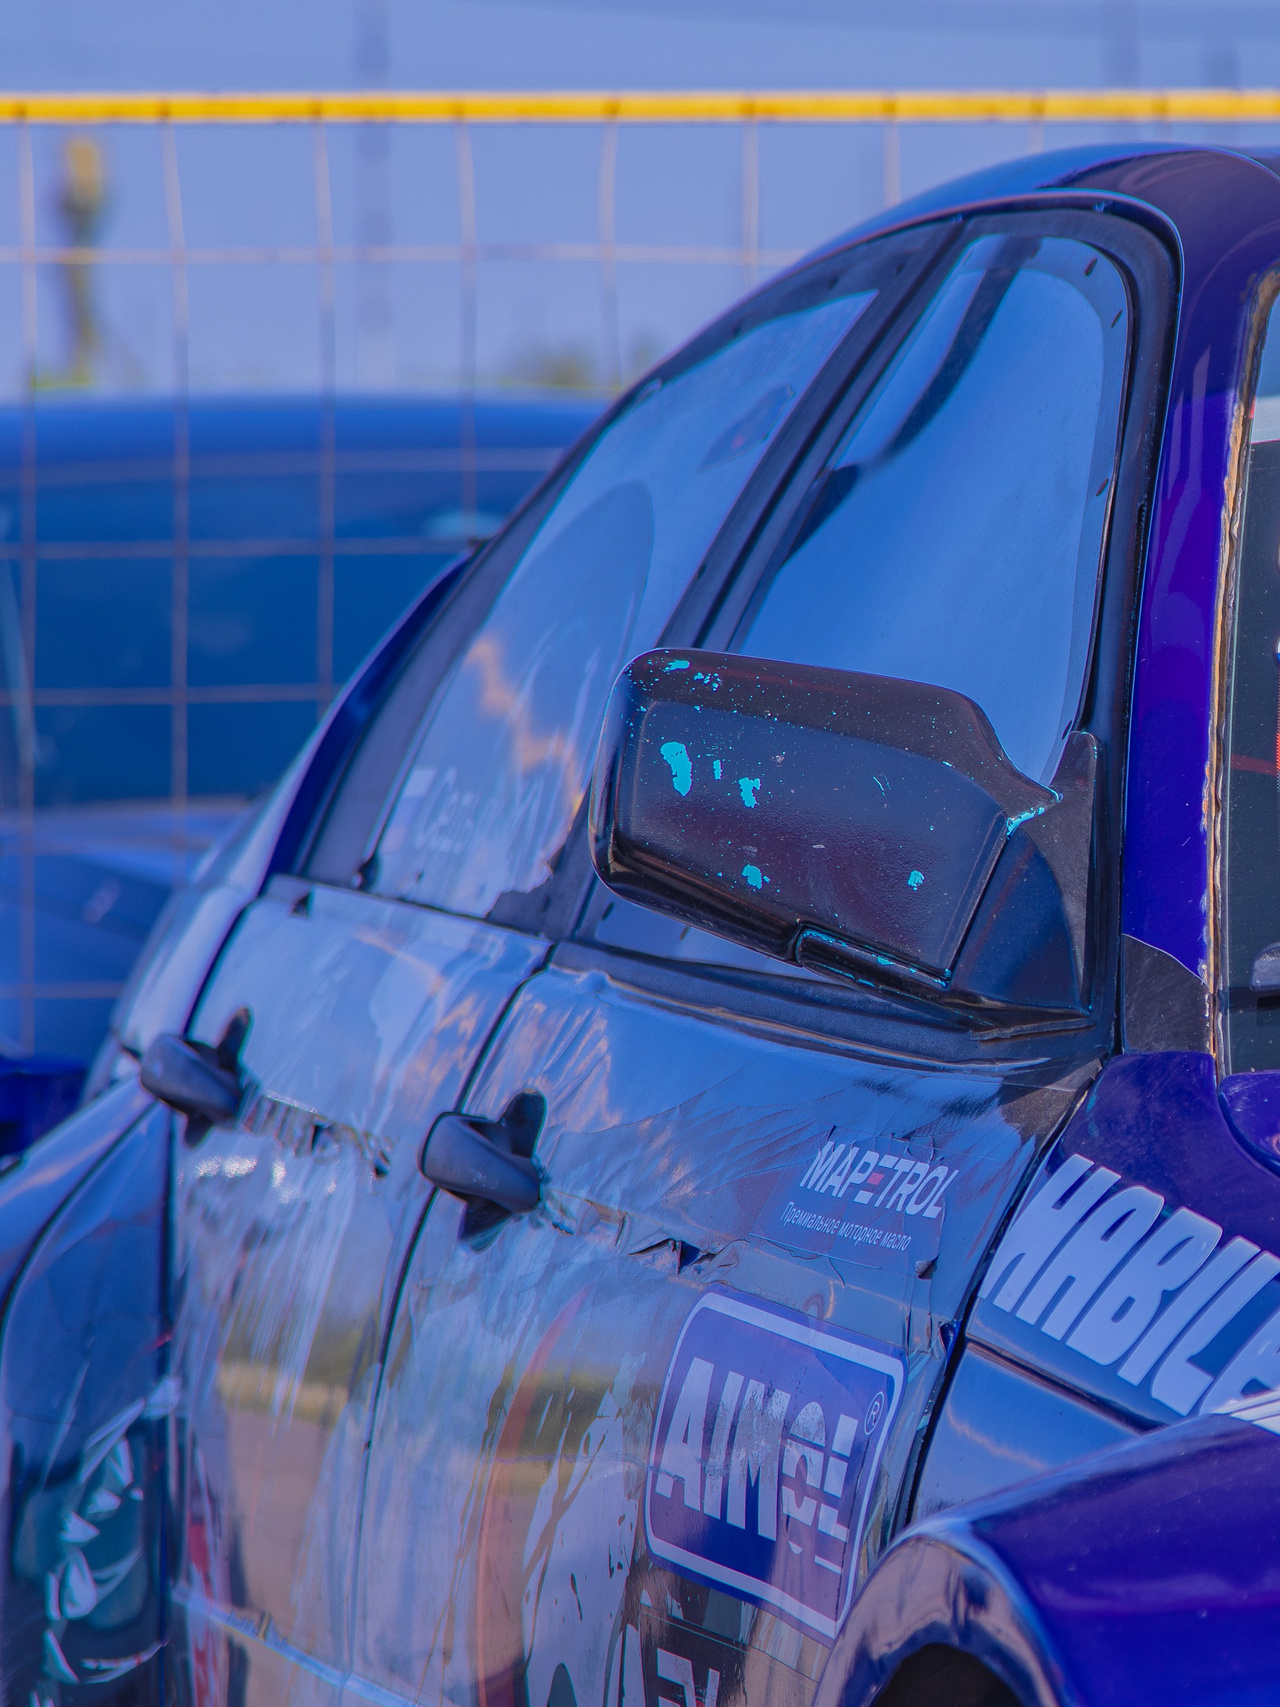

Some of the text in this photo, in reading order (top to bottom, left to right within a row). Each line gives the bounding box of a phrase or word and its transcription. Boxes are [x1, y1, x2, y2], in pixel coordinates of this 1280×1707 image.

[800, 1140, 959, 1219] MAPETROL
[780, 1201, 912, 1251] Премиальное моторное масло
